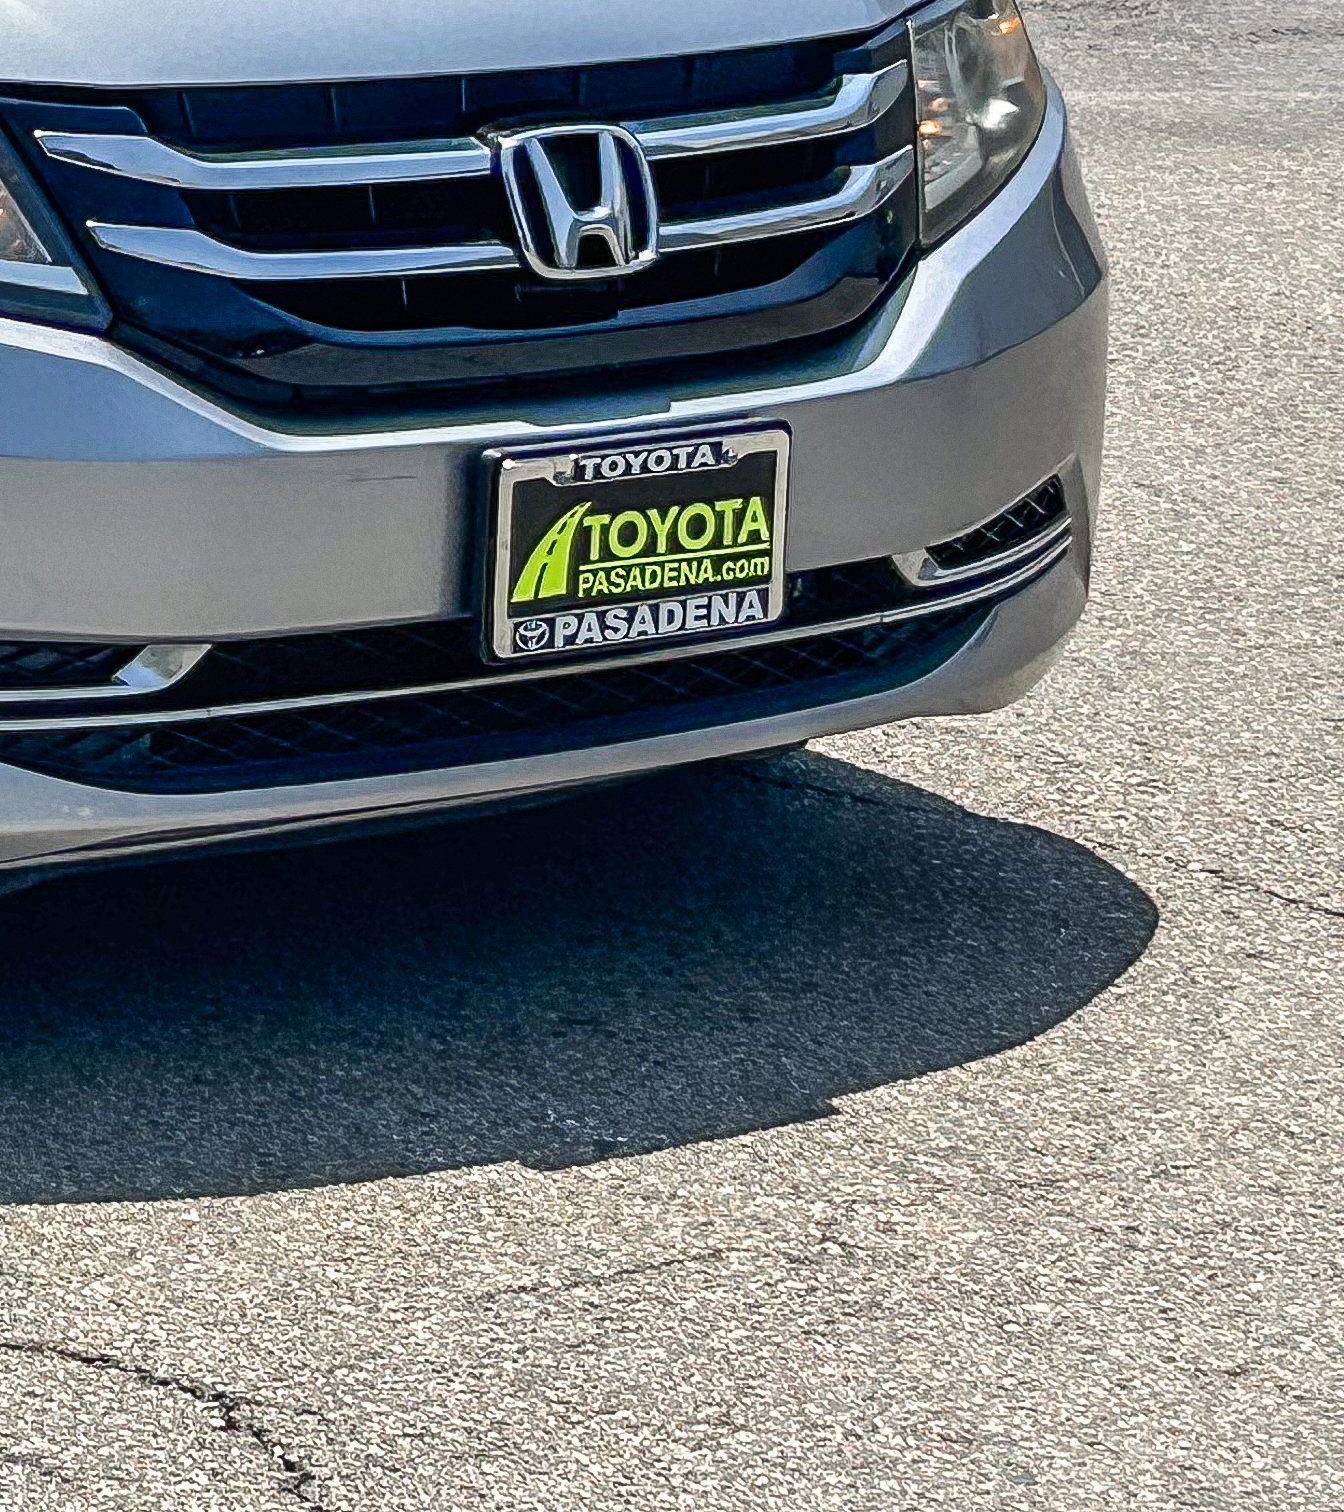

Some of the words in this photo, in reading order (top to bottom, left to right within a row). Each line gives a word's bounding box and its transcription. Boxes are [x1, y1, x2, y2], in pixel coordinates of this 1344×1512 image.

[578, 444, 716, 481] TOYOTA
[582, 496, 771, 561] TOYOTA
[578, 556, 770, 598] PASADENA.com
[554, 589, 764, 648] PASADENA
